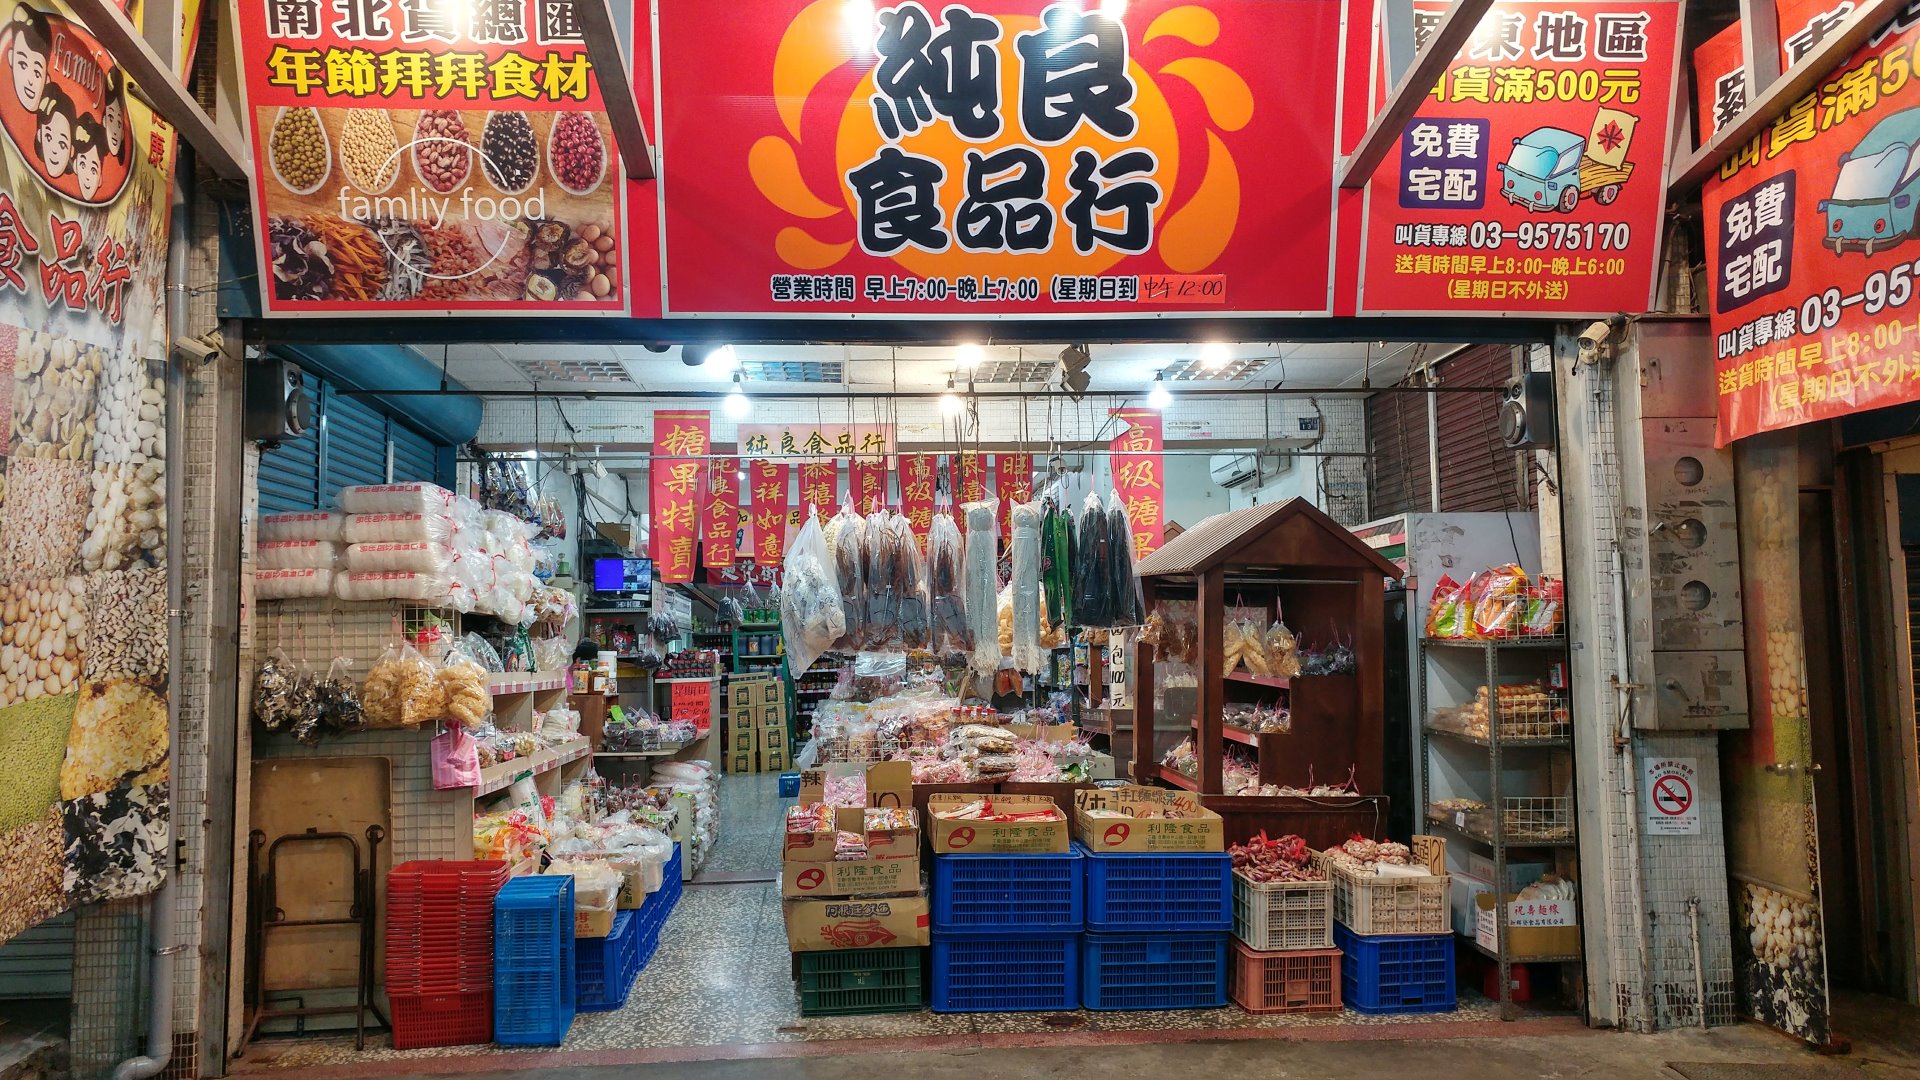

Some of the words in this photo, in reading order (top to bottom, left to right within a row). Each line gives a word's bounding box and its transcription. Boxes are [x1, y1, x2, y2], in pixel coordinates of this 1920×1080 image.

[53, 31, 106, 110] Family
[267, 46, 593, 100] 年節拜拜食材
[874, 4, 1135, 143] 純良
[1720, 45, 1920, 181] 叫貨滿5
[1410, 122, 1480, 159] 免費
[849, 148, 1158, 254] 食品行
[1408, 166, 1477, 202] 宅配
[338, 186, 450, 231] famliy
[460, 186, 547, 222] food
[1725, 181, 1787, 249] 免費
[1394, 223, 1468, 247] 叫貨專線
[1469, 220, 1631, 250] 03-9575170
[771, 275, 855, 302] 營業時間
[864, 276, 1039, 301] 早上7:00-晚上7:00
[1050, 275, 1139, 303] (星期日到
[1394, 254, 1626, 276] 送貨時間早上8:00-晚上6:00
[1724, 238, 1783, 299] 宅配
[1447, 279, 1570, 301] (星期日不外送)
[1718, 308, 1797, 359] 叫貨專線
[1719, 315, 1920, 395] 送貨時間早上8:00-
[746, 431, 888, 459] 純良食品行
[659, 424, 708, 571] 糖果特賣
[753, 459, 785, 558] 吉祥如意
[992, 826, 1056, 837] 利隆食品
[1147, 823, 1210, 834] 利隆食品
[836, 863, 902, 877] 利隆食品
